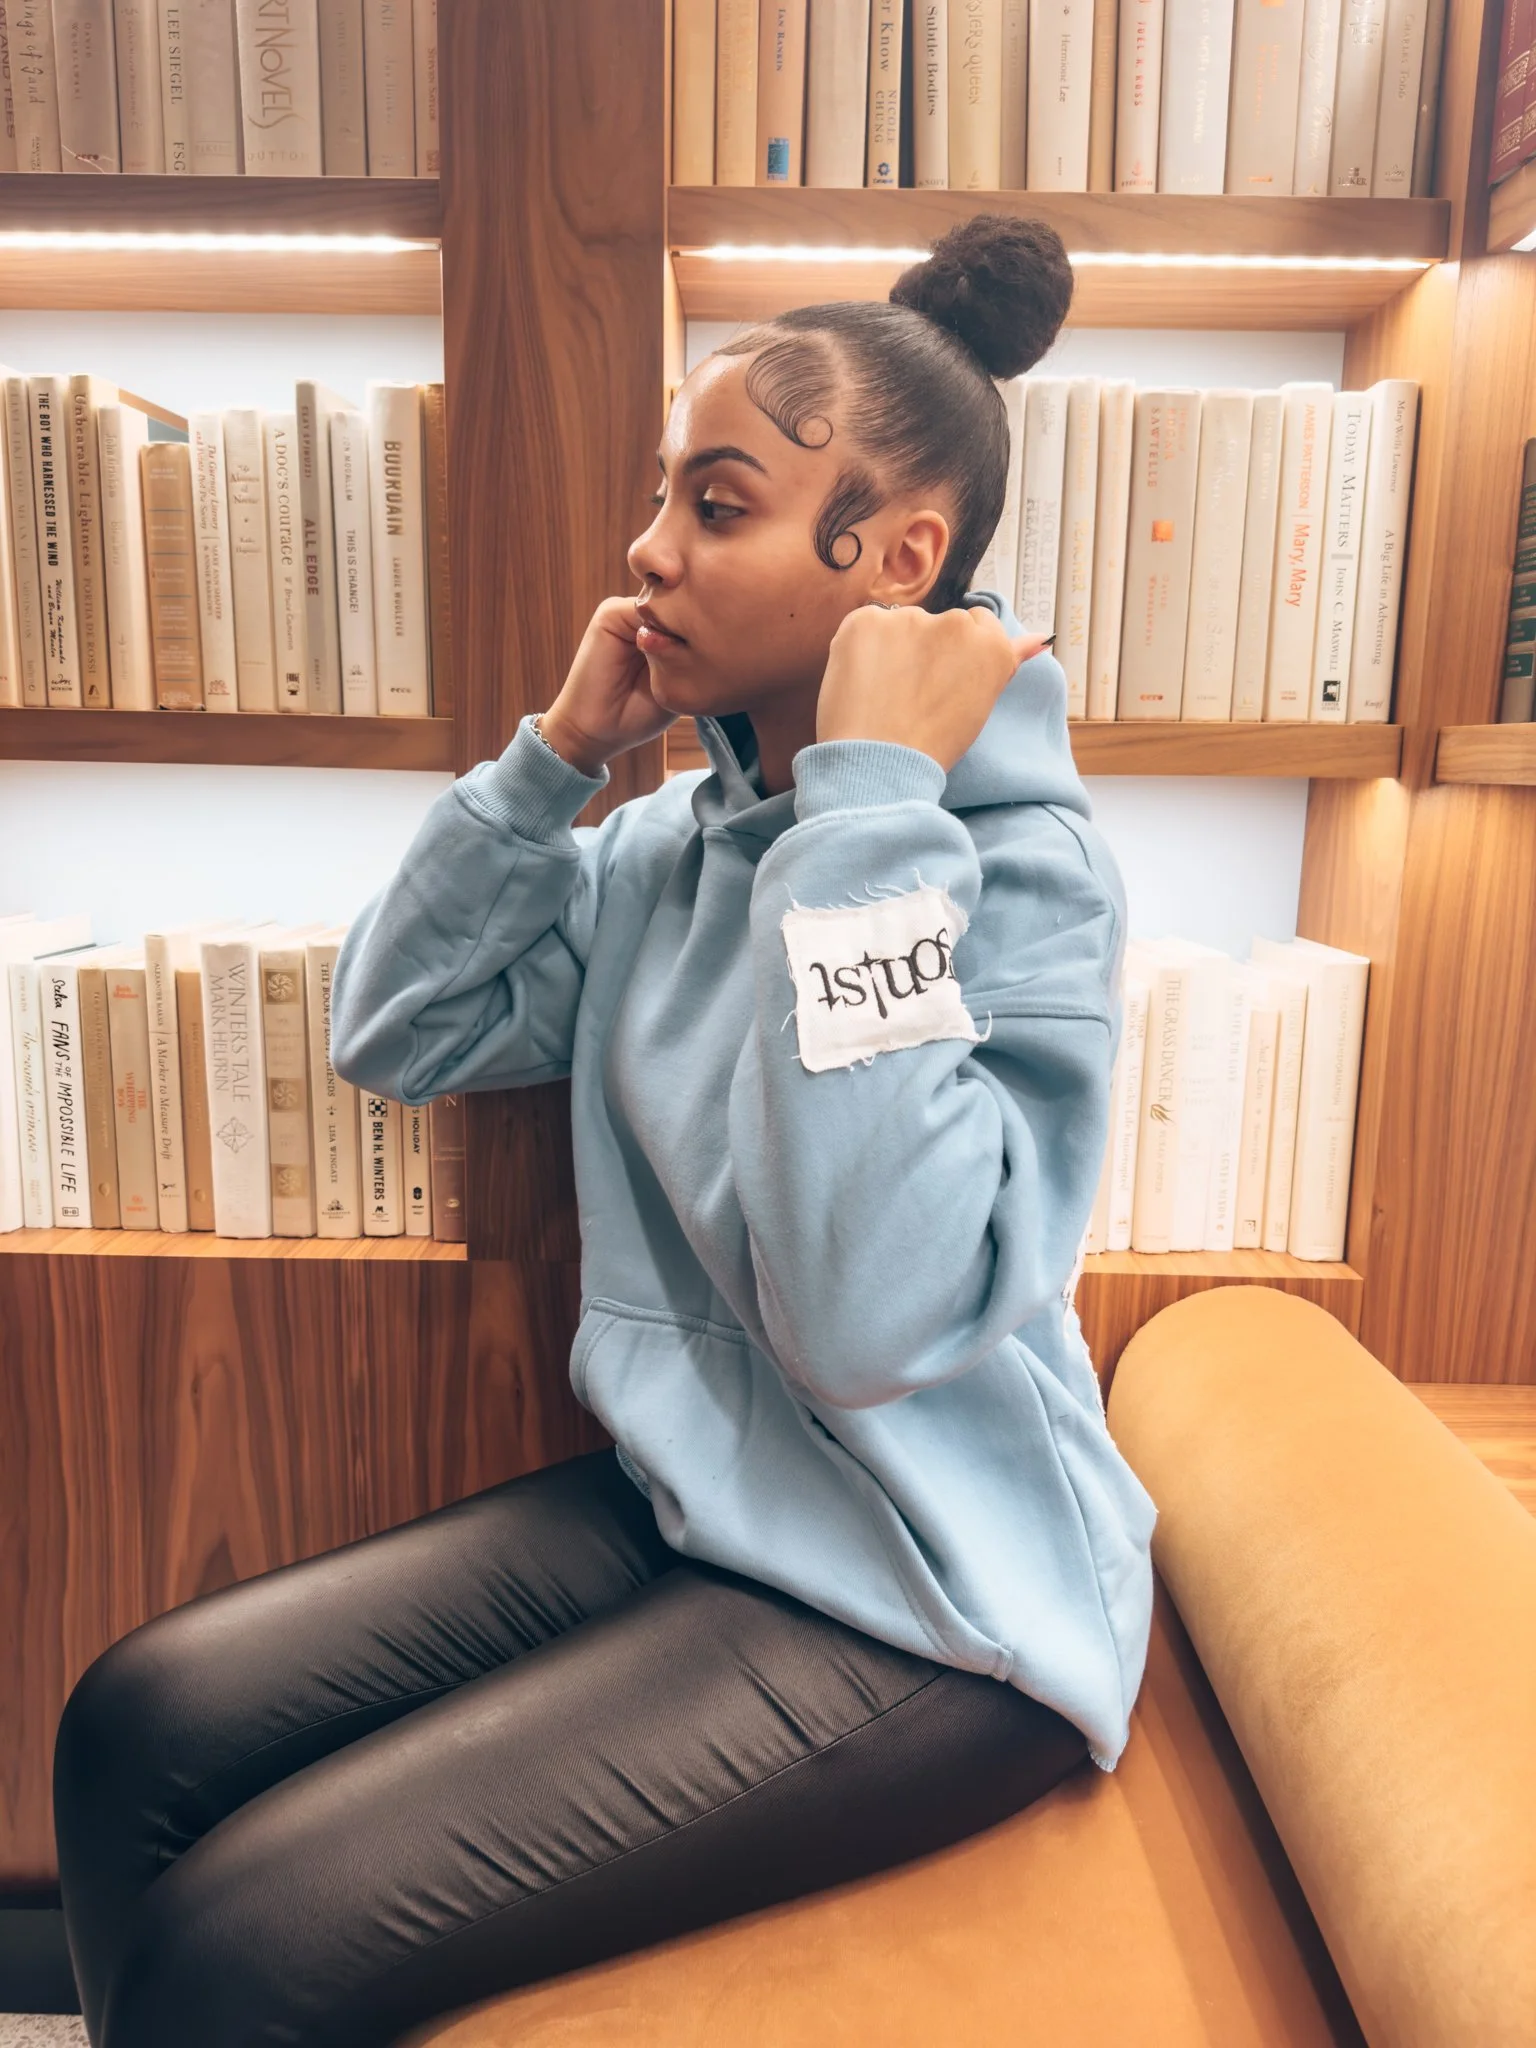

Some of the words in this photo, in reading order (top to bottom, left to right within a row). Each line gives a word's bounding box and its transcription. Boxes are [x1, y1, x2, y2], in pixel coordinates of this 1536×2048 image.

[167, 9, 180, 40] LEE
[777, 8, 787, 28] IAN
[927, 6, 939, 57] Subtle
[1137, 21, 1147, 50] JOEL
[19, 45, 43, 60] of
[775, 32, 786, 72] RANKIN
[879, 22, 895, 72] Know
[1060, 34, 1073, 83] Hermione
[170, 46, 183, 105] SIEGEL
[249, 27, 305, 130] NOVELS
[927, 62, 939, 116] Bodies
[963, 55, 983, 105] QUEEN
[1059, 86, 1070, 103] Lee
[874, 90, 885, 145] CHUNG
[887, 89, 898, 146] NICOLE
[173, 142, 186, 173] FSG
[248, 151, 309, 162] DUTTO
[38, 393, 49, 409] THE
[1394, 400, 1406, 422] Mary
[39, 414, 51, 433] BOY
[73, 393, 90, 486] Unbearable
[274, 428, 286, 440] A
[1303, 403, 1316, 441] JAMES
[1342, 410, 1362, 465] TODAY
[41, 436, 53, 457] WHO
[207, 444, 217, 458] The
[1147, 407, 1160, 488] SAWTELLE
[275, 444, 290, 490] DOG'S
[1298, 444, 1314, 509] PATTERSON
[1389, 453, 1401, 494] Lawrence
[42, 461, 57, 518] HARNESSED
[384, 440, 404, 536] BOURDAIN
[1040, 500, 1057, 557] MORE
[1337, 474, 1358, 548] MATTERS
[46, 521, 57, 539] THE
[76, 492, 92, 568] Lightness
[304, 519, 317, 548] ALL
[346, 529, 357, 553] THIS
[1289, 523, 1310, 565] Mary,
[1384, 529, 1395, 539] A
[47, 542, 59, 567] WIND
[347, 556, 357, 565] IS
[1021, 498, 1040, 624] HEARTBREAK
[1071, 519, 1088, 594] TEACHER
[1380, 542, 1394, 562] Big
[305, 555, 319, 596] EDGE
[348, 568, 359, 613] CHANCE!
[1039, 563, 1055, 587] DIE
[1285, 569, 1307, 607] Mary
[1334, 567, 1347, 596] JOHN
[1381, 566, 1392, 585] Life
[83, 577, 94, 620] PORTIA
[1037, 599, 1051, 623] OF
[1379, 588, 1389, 600] in
[85, 622, 94, 638] DE
[1069, 605, 1084, 646] MAN
[1372, 601, 1389, 665] Advertising
[85, 641, 96, 674] ROSSI
[1329, 620, 1344, 672] MAXWELL
[320, 962, 330, 983] THE
[1165, 978, 1182, 1004] THE
[51, 978, 67, 1009] Scelsa
[209, 974, 227, 1026] MARK
[321, 986, 331, 1014] BOOK
[51, 1020, 73, 1060] FANS
[157, 1038, 167, 1046] A
[1163, 1007, 1180, 1047] GRASS
[55, 1062, 63, 1077] THE
[64, 1066, 71, 1077] OF
[158, 1048, 170, 1082] Marker
[212, 1031, 230, 1092] HELPRIN
[323, 1056, 336, 1097] RIENDS
[1157, 1050, 1176, 1101] DANCER
[125, 1071, 136, 1123] WHIPPING
[159, 1085, 169, 1095] to
[232, 1058, 251, 1103] TALE
[57, 1081, 75, 1156] IMPOSSIBLE
[160, 1098, 171, 1135] Measure
[328, 1124, 337, 1143] LISA
[373, 1121, 384, 1141] BEN
[160, 1137, 174, 1160] Drift
[373, 1144, 384, 1154] H.
[412, 1117, 421, 1154] HOLIDAY
[60, 1163, 76, 1194] LIFE
[329, 1146, 338, 1184] WINGATE
[374, 1157, 385, 1200] WINTERS
